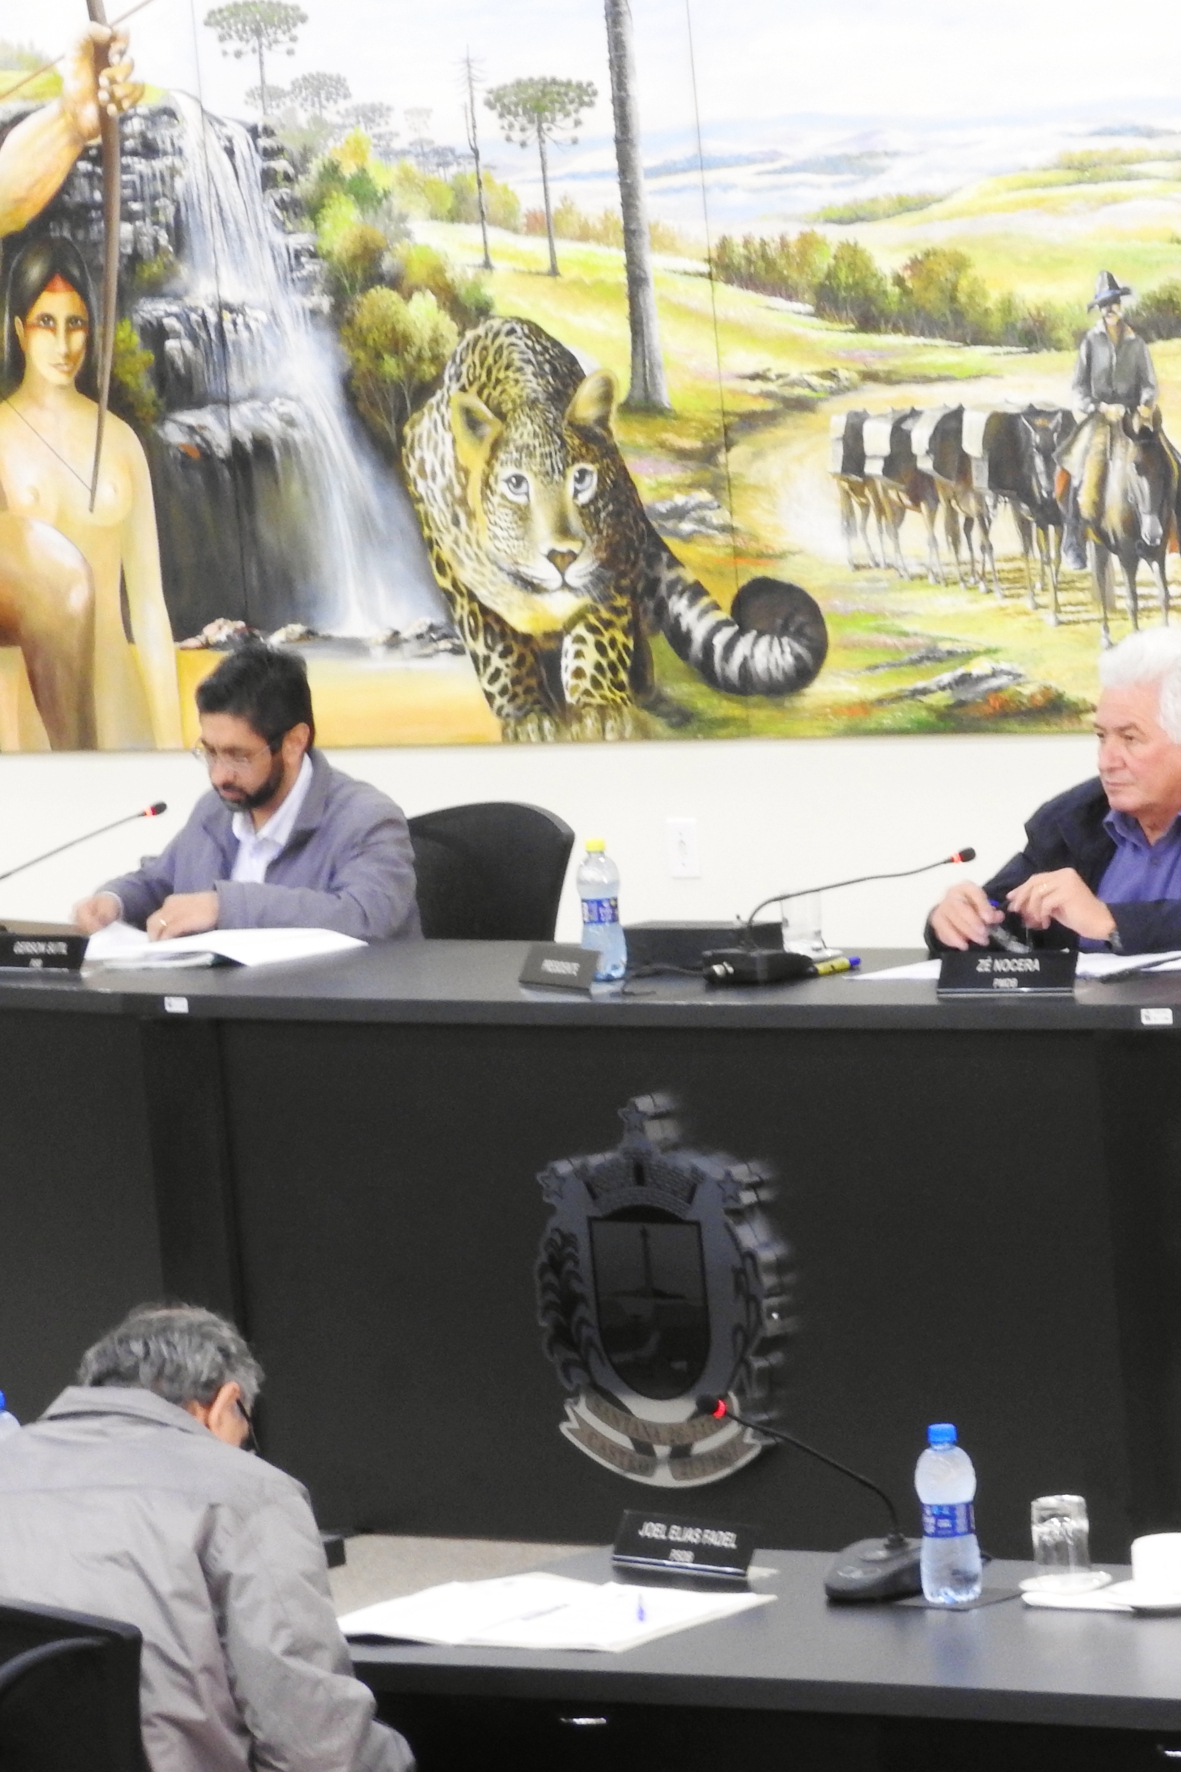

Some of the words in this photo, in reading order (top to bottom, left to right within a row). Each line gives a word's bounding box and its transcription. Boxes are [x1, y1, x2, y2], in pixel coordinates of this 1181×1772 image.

[976, 955, 992, 973] ZÉ
[993, 958, 1040, 972] NOCERA
[638, 1521, 667, 1540] JOEL
[668, 1525, 702, 1544] ELIAS
[701, 1529, 738, 1549] FADEL
